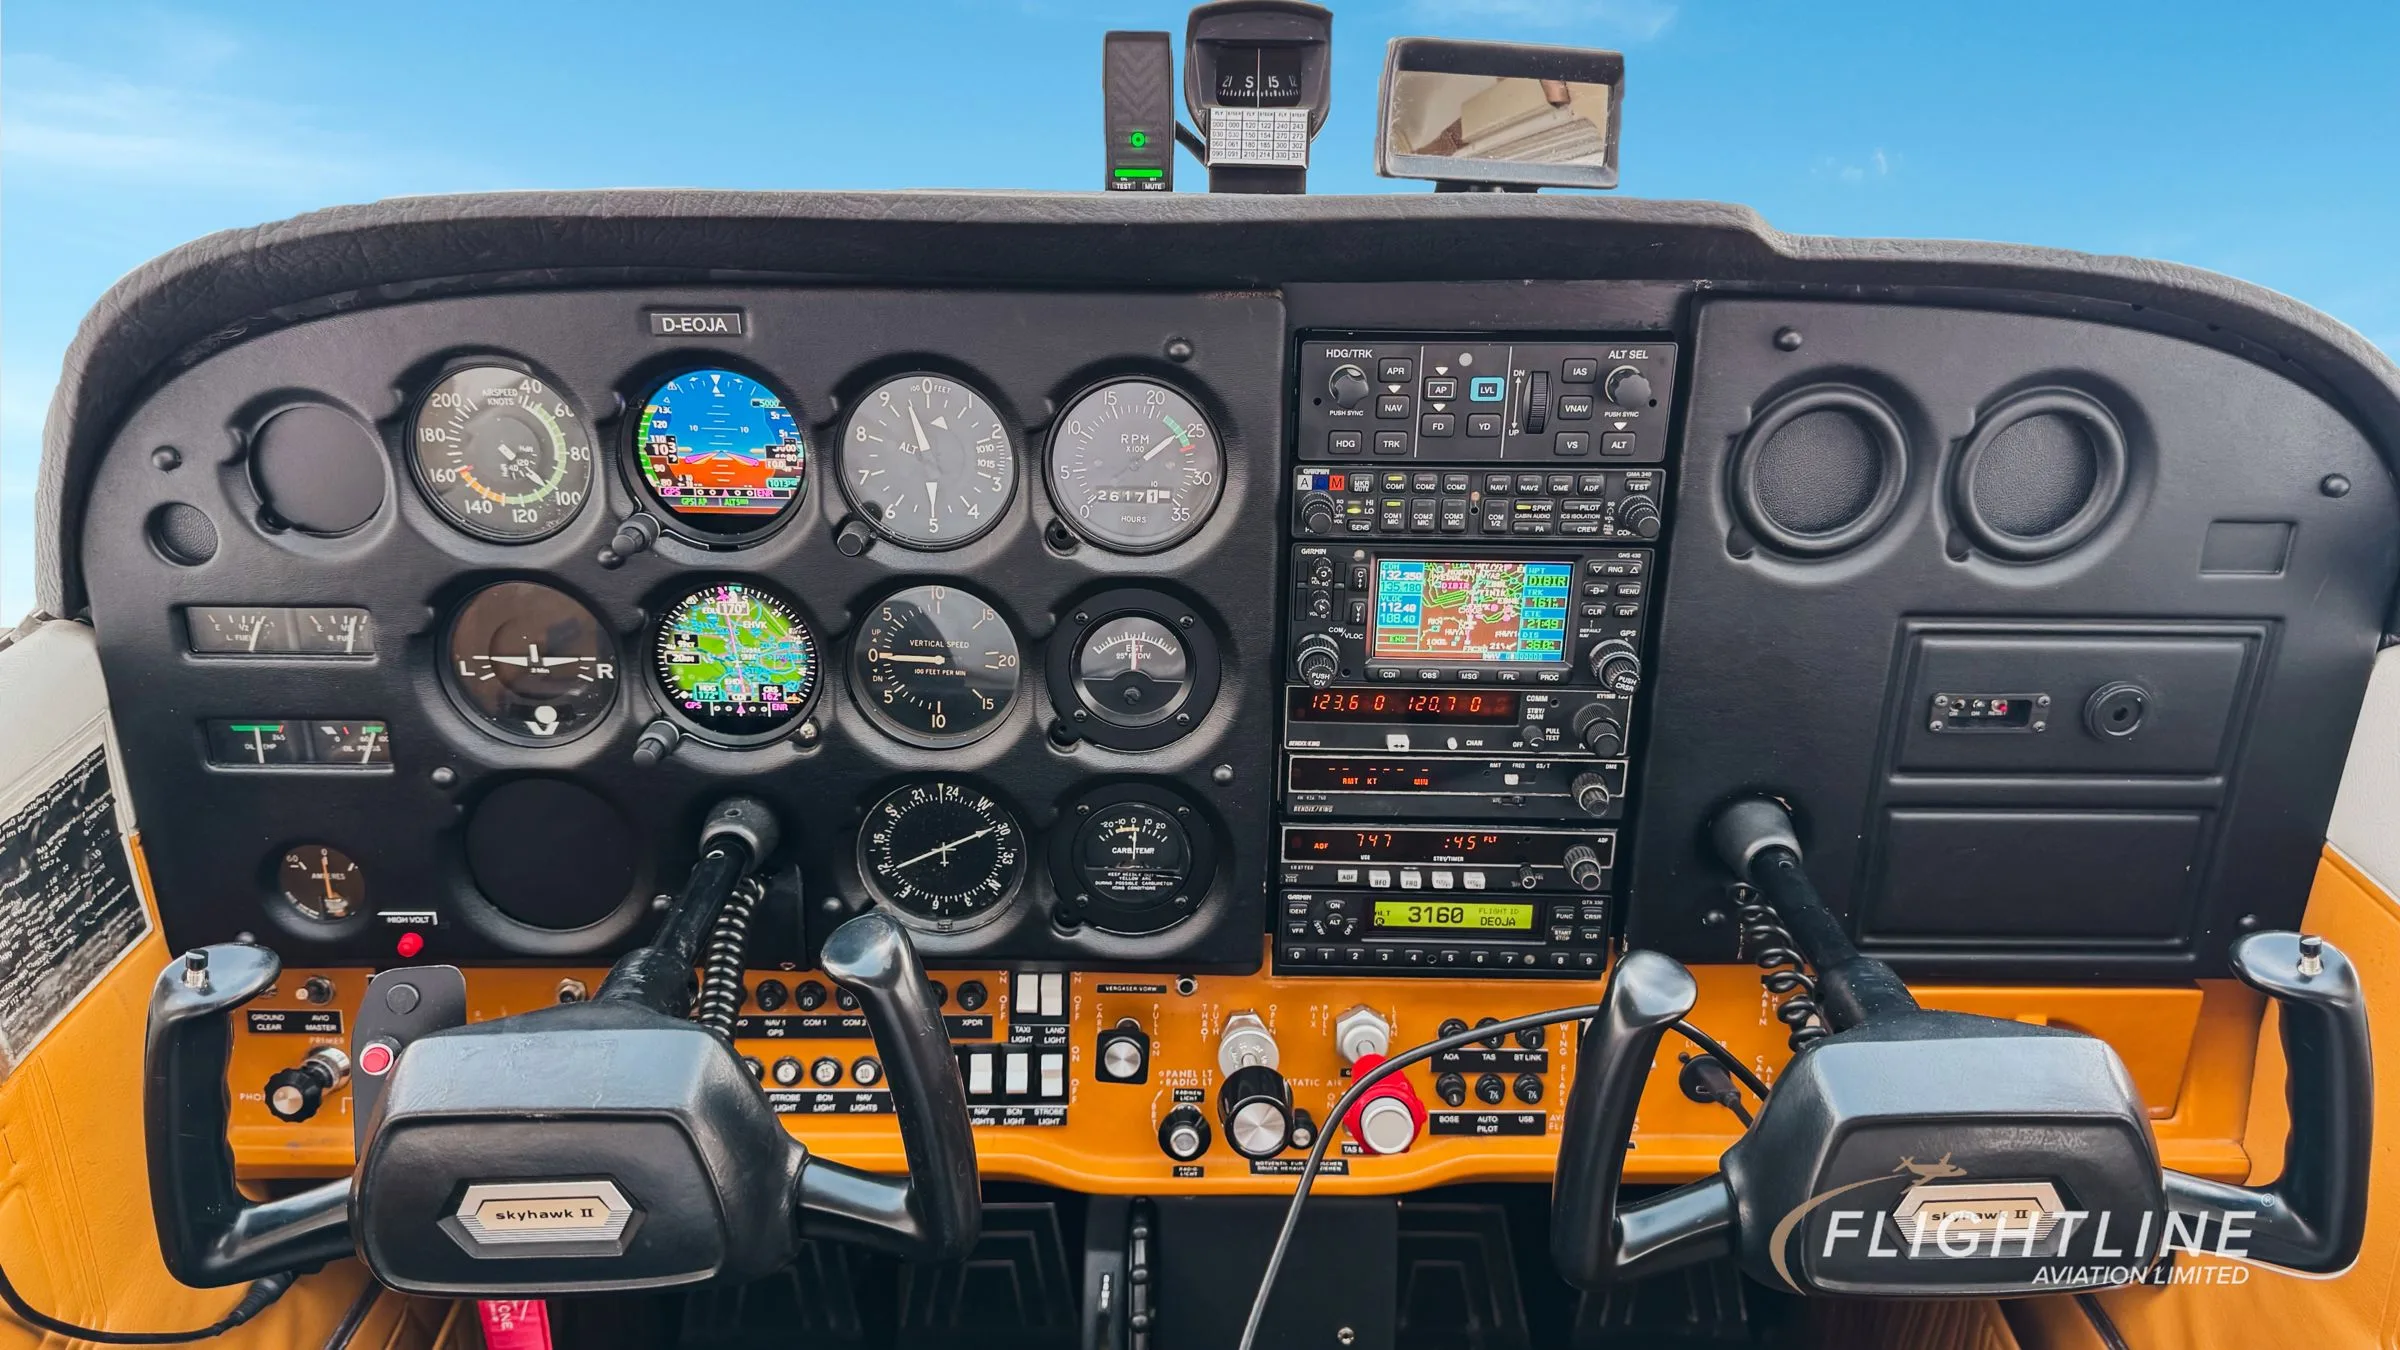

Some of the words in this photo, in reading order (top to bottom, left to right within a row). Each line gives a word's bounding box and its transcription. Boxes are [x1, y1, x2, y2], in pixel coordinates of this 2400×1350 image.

[1245, 76, 1254, 89] S
[1268, 76, 1280, 88] 15
[662, 317, 728, 334] D-EOJA
[1326, 350, 1373, 358] HDG/TRK
[1608, 351, 1627, 359] ALT
[1629, 351, 1648, 359] SEL
[1387, 367, 1404, 375] APR
[1573, 368, 1587, 376] IAS
[519, 380, 542, 394] 40
[934, 384, 951, 394] FEET
[1435, 386, 1447, 394] AP
[1480, 386, 1494, 394] LVL
[482, 388, 518, 397] AIRSPEED
[432, 393, 461, 408] 200
[488, 398, 514, 406] KNOTS
[1104, 391, 1117, 405] 15
[1146, 391, 1165, 405] 20
[1385, 404, 1402, 412] NAV
[1565, 404, 1587, 412] VNAV
[652, 421, 667, 429] 120
[1067, 421, 1080, 435] 10
[1433, 422, 1444, 430] FD
[1479, 422, 1490, 430] YD
[420, 428, 445, 442] 180
[856, 427, 866, 441] 8
[1187, 424, 1205, 438] 25
[1121, 433, 1149, 445] RPM
[1336, 440, 1355, 448] HDG
[1383, 440, 1400, 448] TRK
[899, 442, 918, 455] ALT
[976, 443, 994, 454] 1010
[1126, 445, 1145, 453] X100
[570, 447, 590, 461] 80
[977, 458, 995, 468] 1015
[431, 468, 456, 483] 160
[1386, 483, 1404, 491] COM1
[1416, 483, 1435, 491] COM2
[1490, 484, 1508, 492] NAV1
[1553, 484, 1568, 492] DME
[556, 491, 581, 506] 100
[465, 500, 492, 514] 140
[1532, 504, 1551, 512] SPKR
[1580, 504, 1600, 512] PILOT
[513, 509, 537, 523] 120
[1121, 514, 1147, 523] HOURS
[1171, 508, 1190, 521] 35
[929, 519, 938, 533] 5
[1442, 582, 1470, 590] DIBIR
[1527, 576, 1567, 586] DIBIR
[931, 587, 945, 600] 10
[883, 608, 892, 621] 5
[982, 608, 994, 621] 15
[909, 640, 944, 648] VERTICAL
[947, 640, 970, 649] SPEED
[998, 655, 1016, 667] 20
[459, 660, 475, 676] L
[596, 664, 614, 679] R
[911, 789, 926, 800] 21
[946, 786, 959, 797] 24
[997, 823, 1011, 836] 30
[1357, 834, 1392, 847] 747
[1002, 852, 1014, 865] 33
[410, 916, 429, 924] VOLT
[1408, 907, 1463, 924] 3160
[1480, 917, 1516, 927] DEOJA
[1044, 1036, 1065, 1044] LIGHT
[1166, 1070, 1199, 1078] PANEL
[1166, 1078, 1198, 1086] RADIO
[1201, 1078, 1212, 1086] LT
[1477, 1125, 1498, 1133] PILOT
[496, 1209, 574, 1221] skyhawk
[580, 1208, 594, 1217] II
